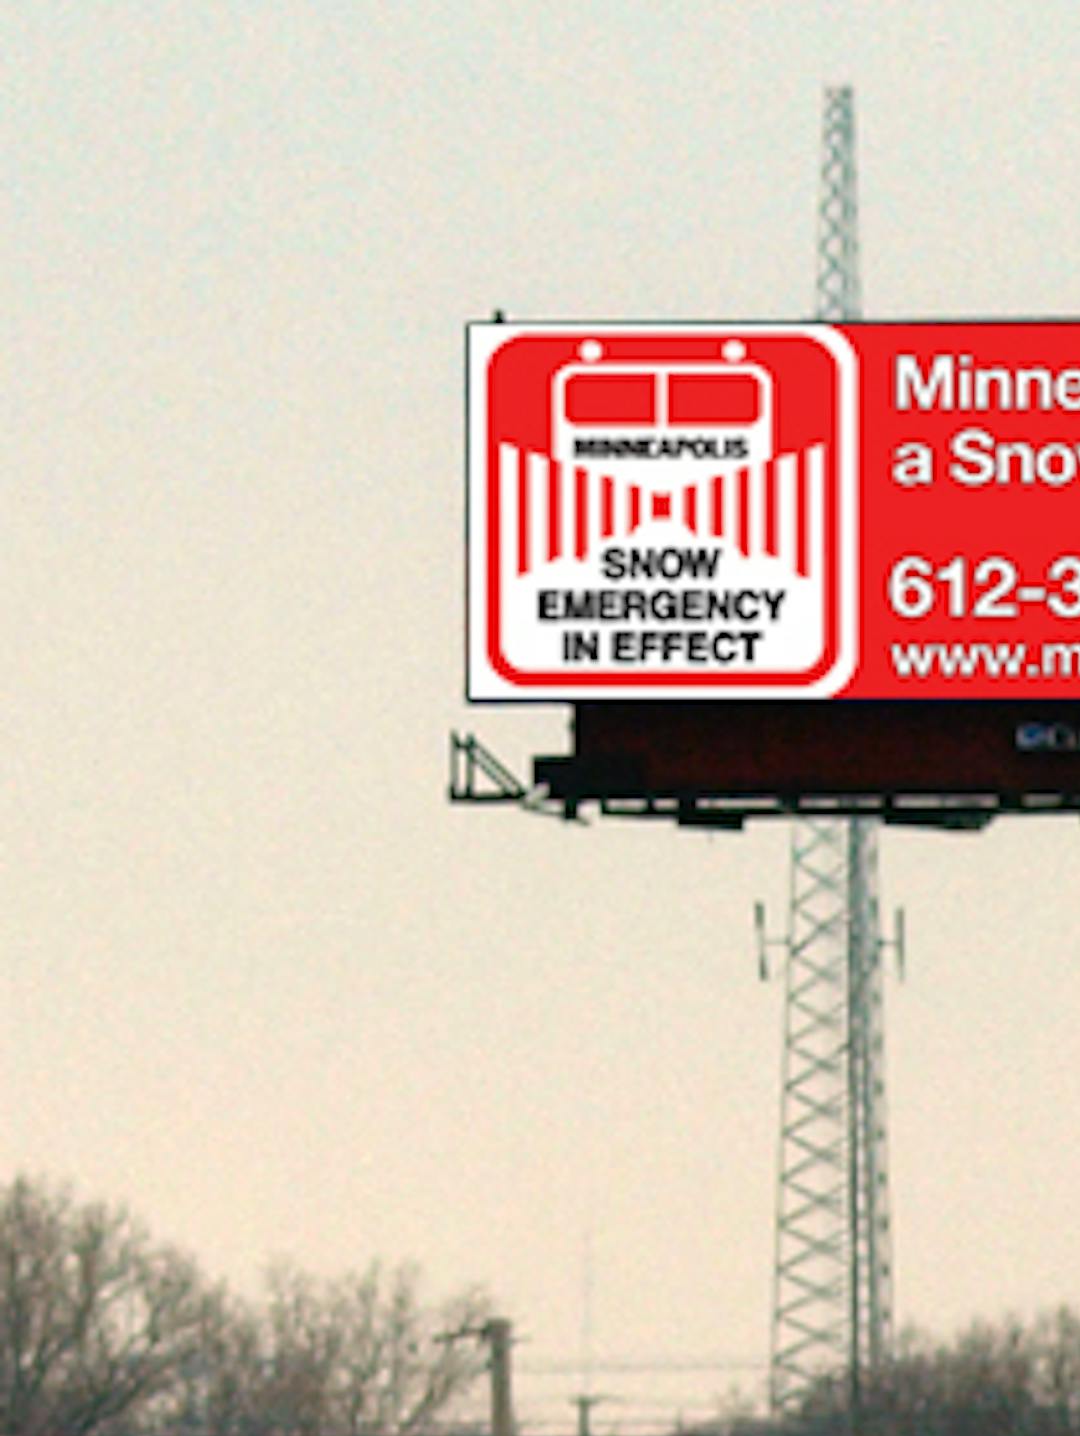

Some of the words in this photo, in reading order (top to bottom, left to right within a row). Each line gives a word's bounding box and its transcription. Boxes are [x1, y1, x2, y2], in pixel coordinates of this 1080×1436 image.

[572, 436, 749, 460] MINNEAPOLIS
[891, 441, 933, 486] a
[601, 547, 721, 580] SNOW
[537, 589, 786, 622] EMERGENCY
[563, 631, 600, 662] IN
[611, 631, 763, 663] EFFECT
